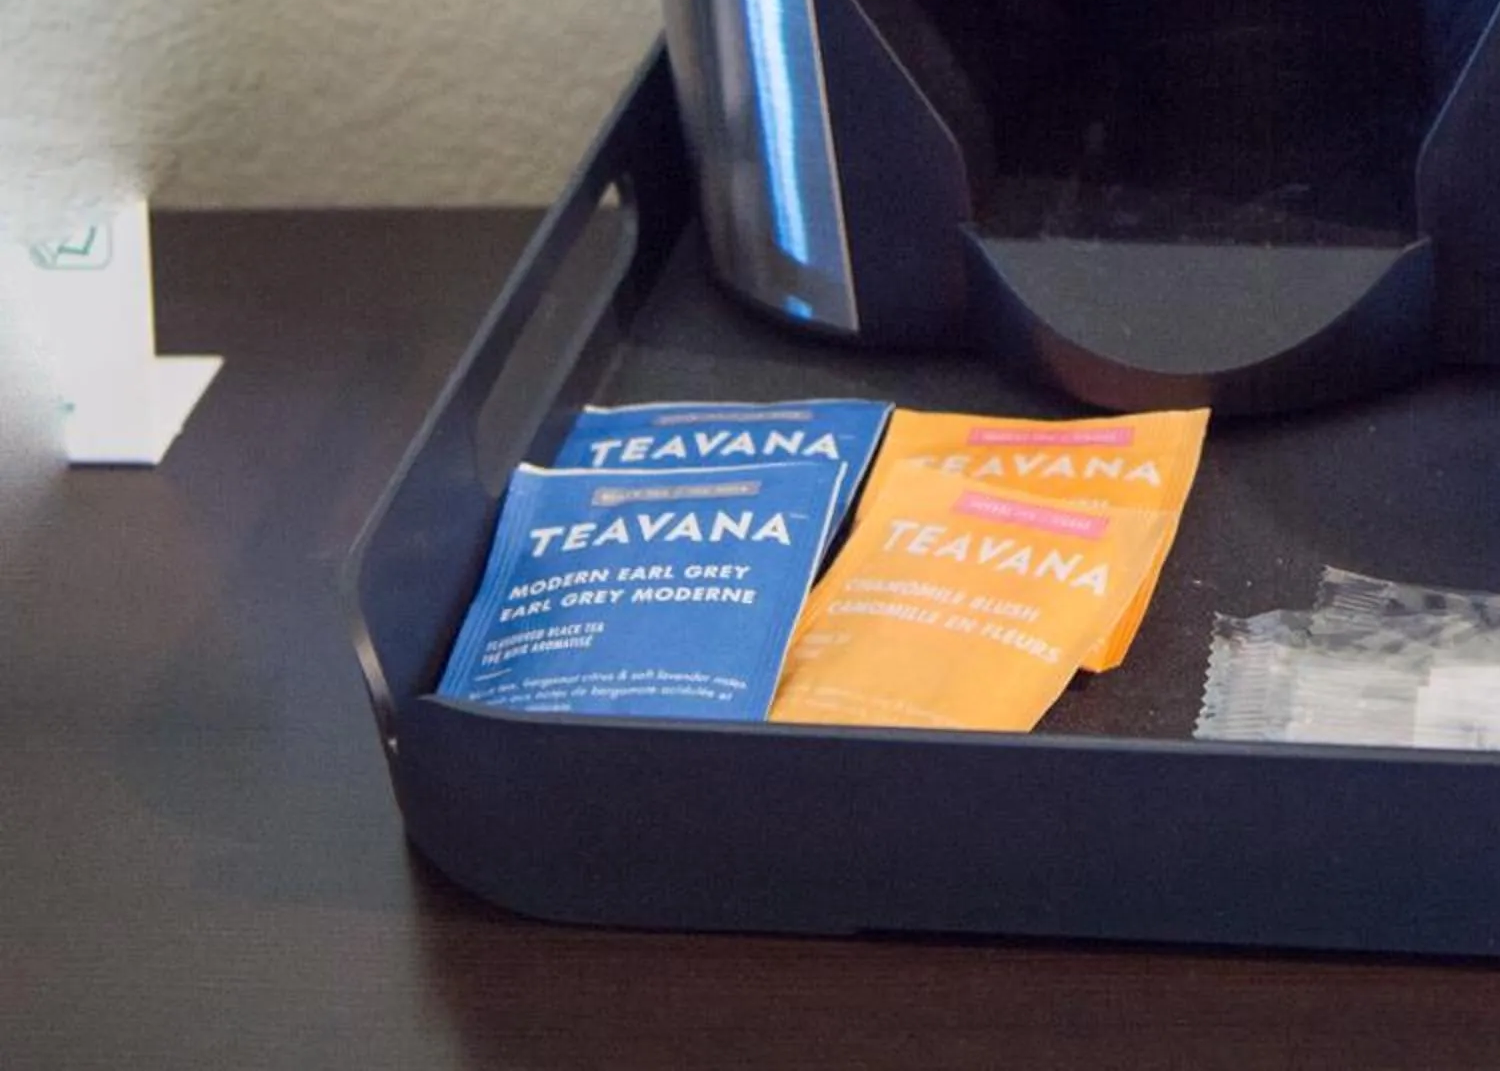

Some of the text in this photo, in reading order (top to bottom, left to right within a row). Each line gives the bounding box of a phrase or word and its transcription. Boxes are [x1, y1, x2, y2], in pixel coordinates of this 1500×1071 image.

[590, 430, 841, 467] TEAVANA
[529, 511, 792, 558] TEAVANA
[882, 519, 1113, 596] TEAVANA
[508, 563, 751, 601] MODERN EARL GREY
[499, 586, 758, 623] EARL GREY MODERNE
